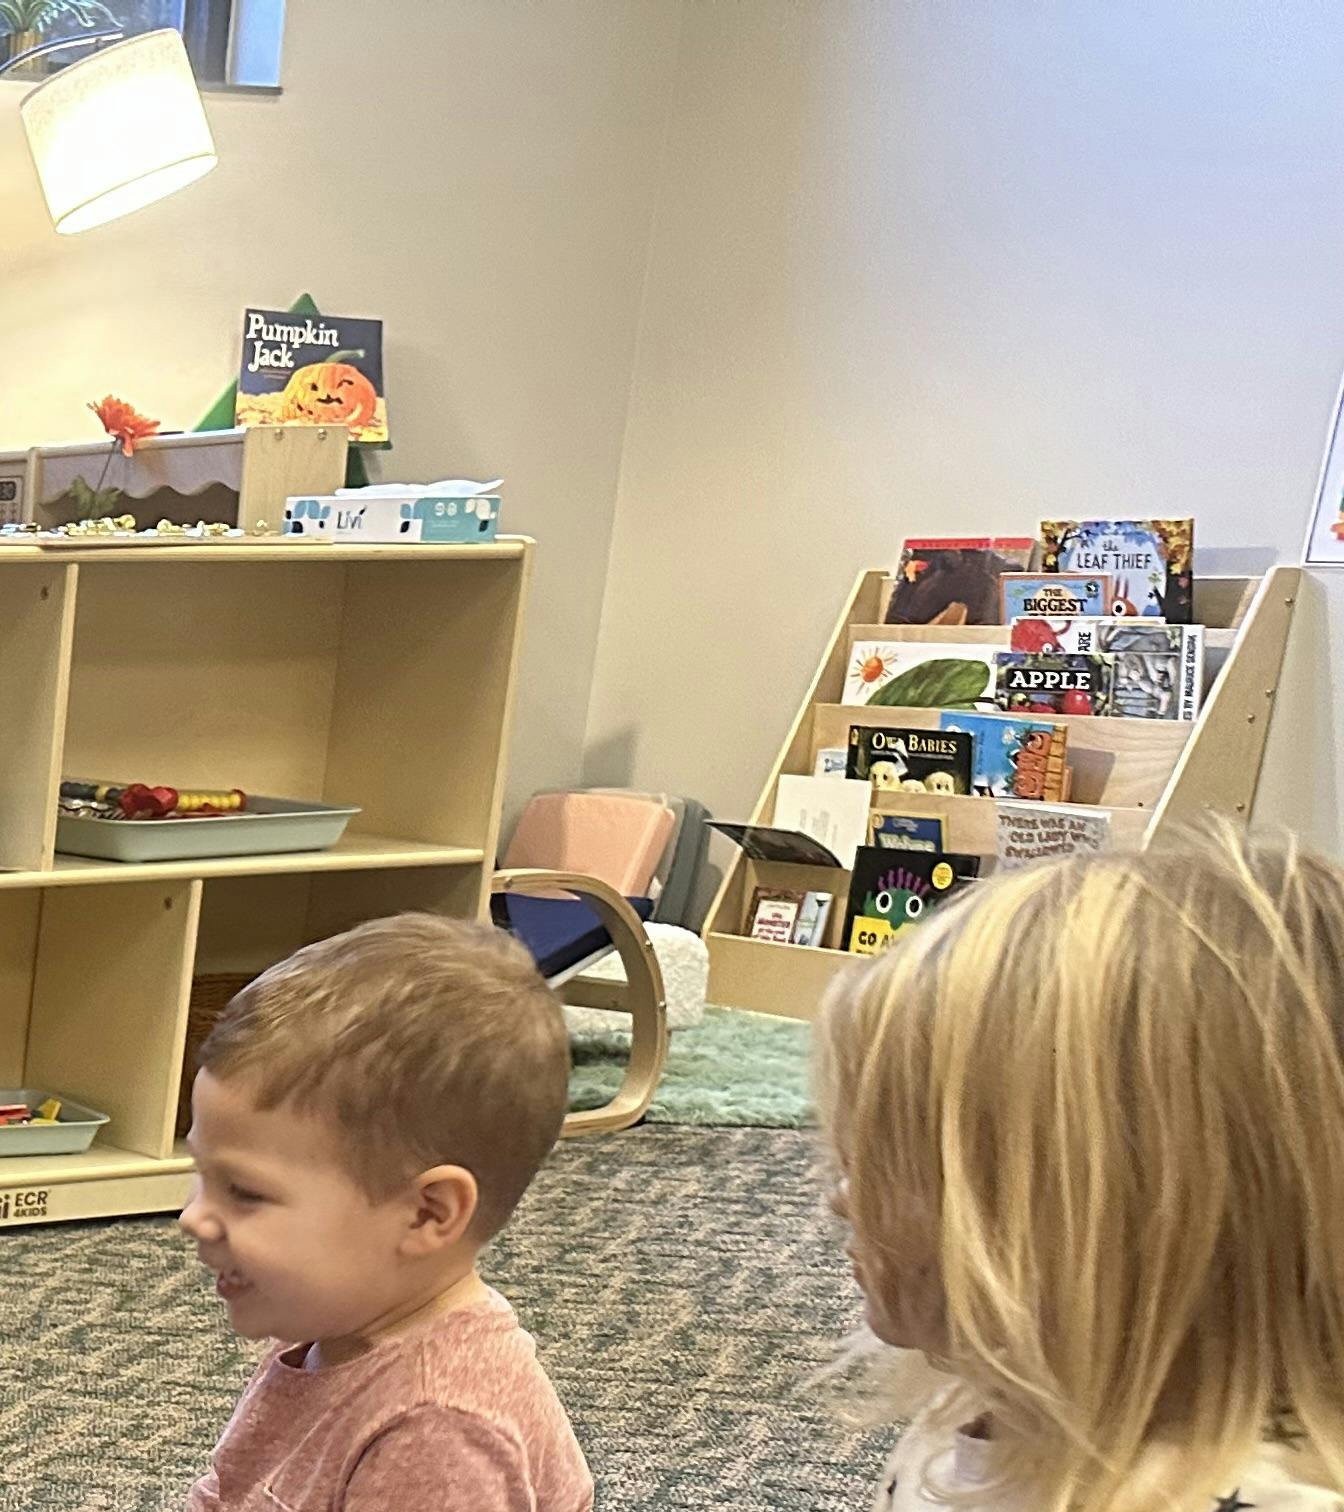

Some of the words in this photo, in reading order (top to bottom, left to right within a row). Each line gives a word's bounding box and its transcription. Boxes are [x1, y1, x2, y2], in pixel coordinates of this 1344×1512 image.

[246, 314, 339, 348] Pumpkin
[248, 341, 294, 372] Jack
[1077, 553, 1109, 570] LEAF
[1113, 553, 1152, 570] THIEF
[1042, 588, 1062, 597] THE
[1023, 599, 1088, 612] BIGGEST
[1078, 632, 1091, 652] ARE
[1010, 671, 1091, 689] APPLE
[858, 931, 876, 946] GO
[15, 1191, 49, 1207] ECR
[14, 1207, 47, 1217] 4KIDS
